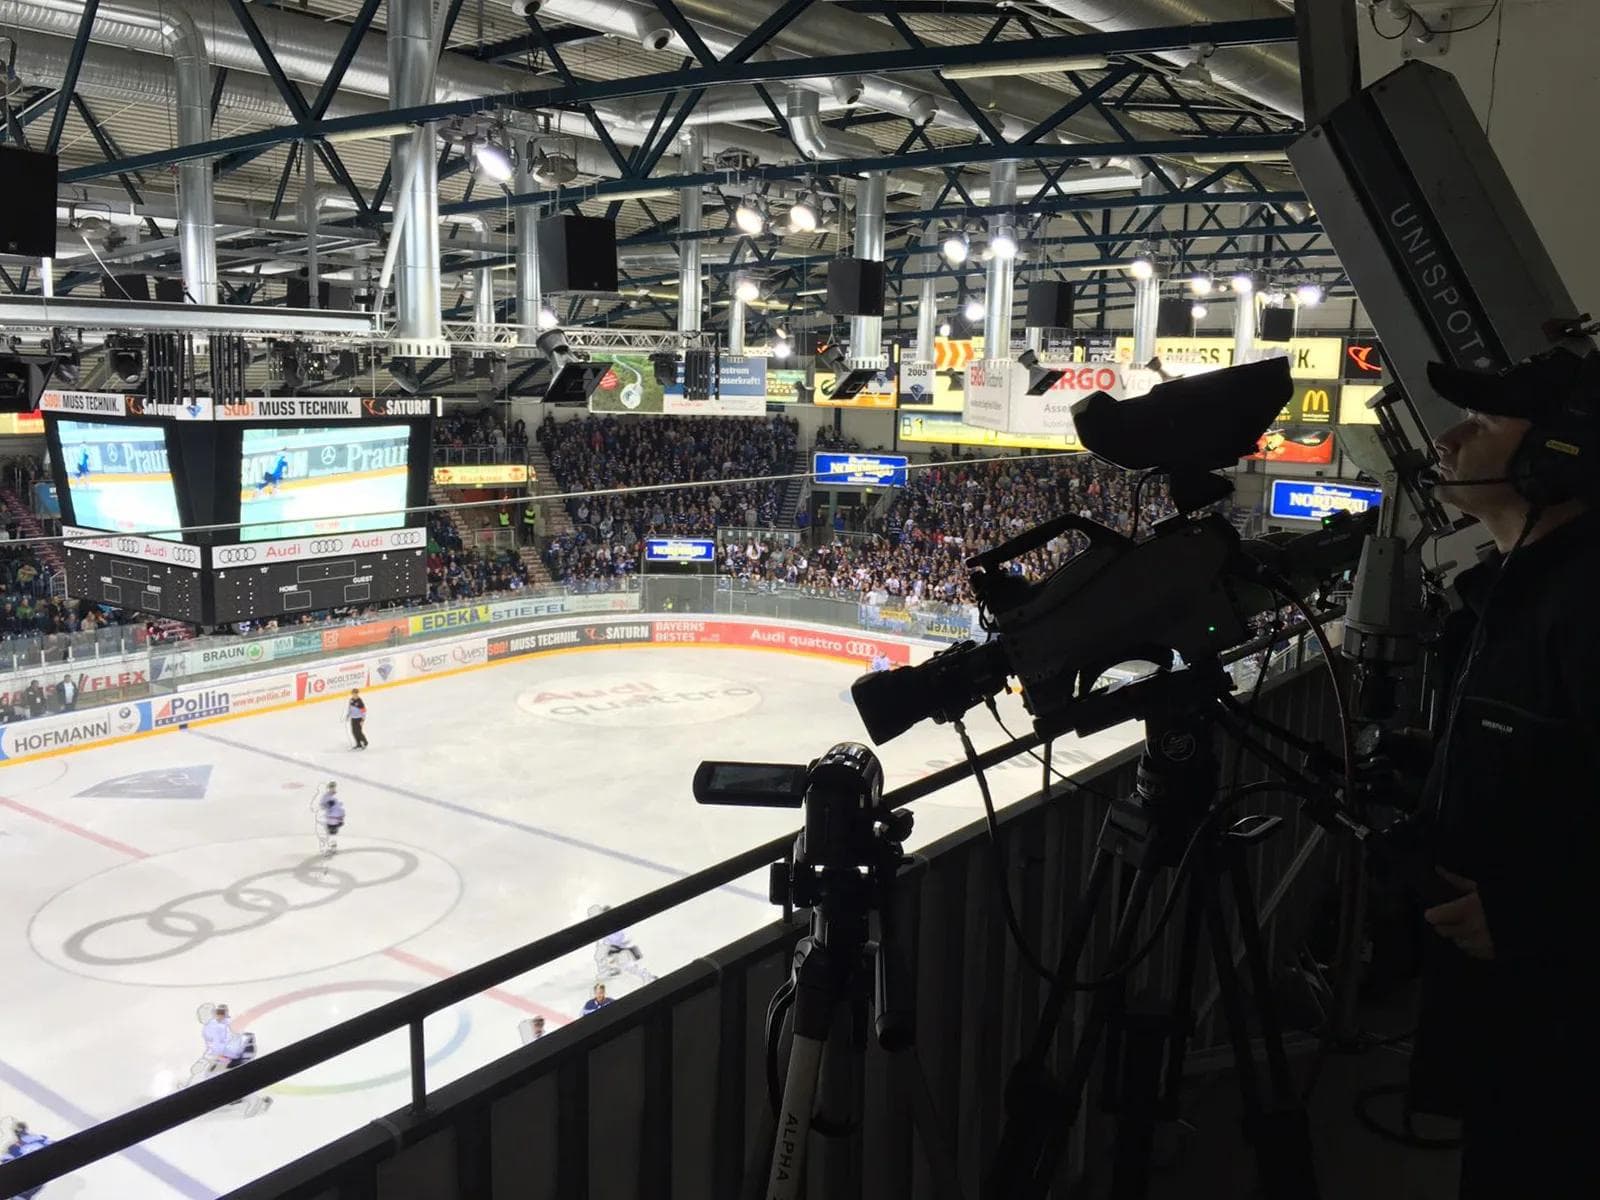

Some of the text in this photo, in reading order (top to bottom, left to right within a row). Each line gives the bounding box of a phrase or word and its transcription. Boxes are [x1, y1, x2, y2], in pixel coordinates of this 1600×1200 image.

[1391, 203, 1484, 351] UNISPOT
[908, 369, 928, 377] 2005
[1048, 368, 1116, 391] RGO
[62, 396, 85, 411] MUSS
[86, 397, 120, 413] TECHNIK.
[259, 402, 296, 416] MUSS
[298, 401, 352, 416] TECHNIK.
[386, 400, 431, 415] SATURN
[144, 544, 167, 557] Audi
[266, 537, 384, 558] Audi Audi
[352, 575, 373, 584] GUEST
[422, 610, 480, 630] EDEKA
[492, 603, 567, 621] STIEFEL
[606, 625, 649, 640] SATURN
[751, 631, 843, 652] Audi quattro
[510, 635, 536, 653] MUSS
[203, 647, 245, 662] BRAUN
[92, 671, 146, 691] FLEX
[171, 690, 230, 716] Pollin
[14, 721, 109, 753] HOFMANN
[776, 1112, 799, 1181] ALPHA
